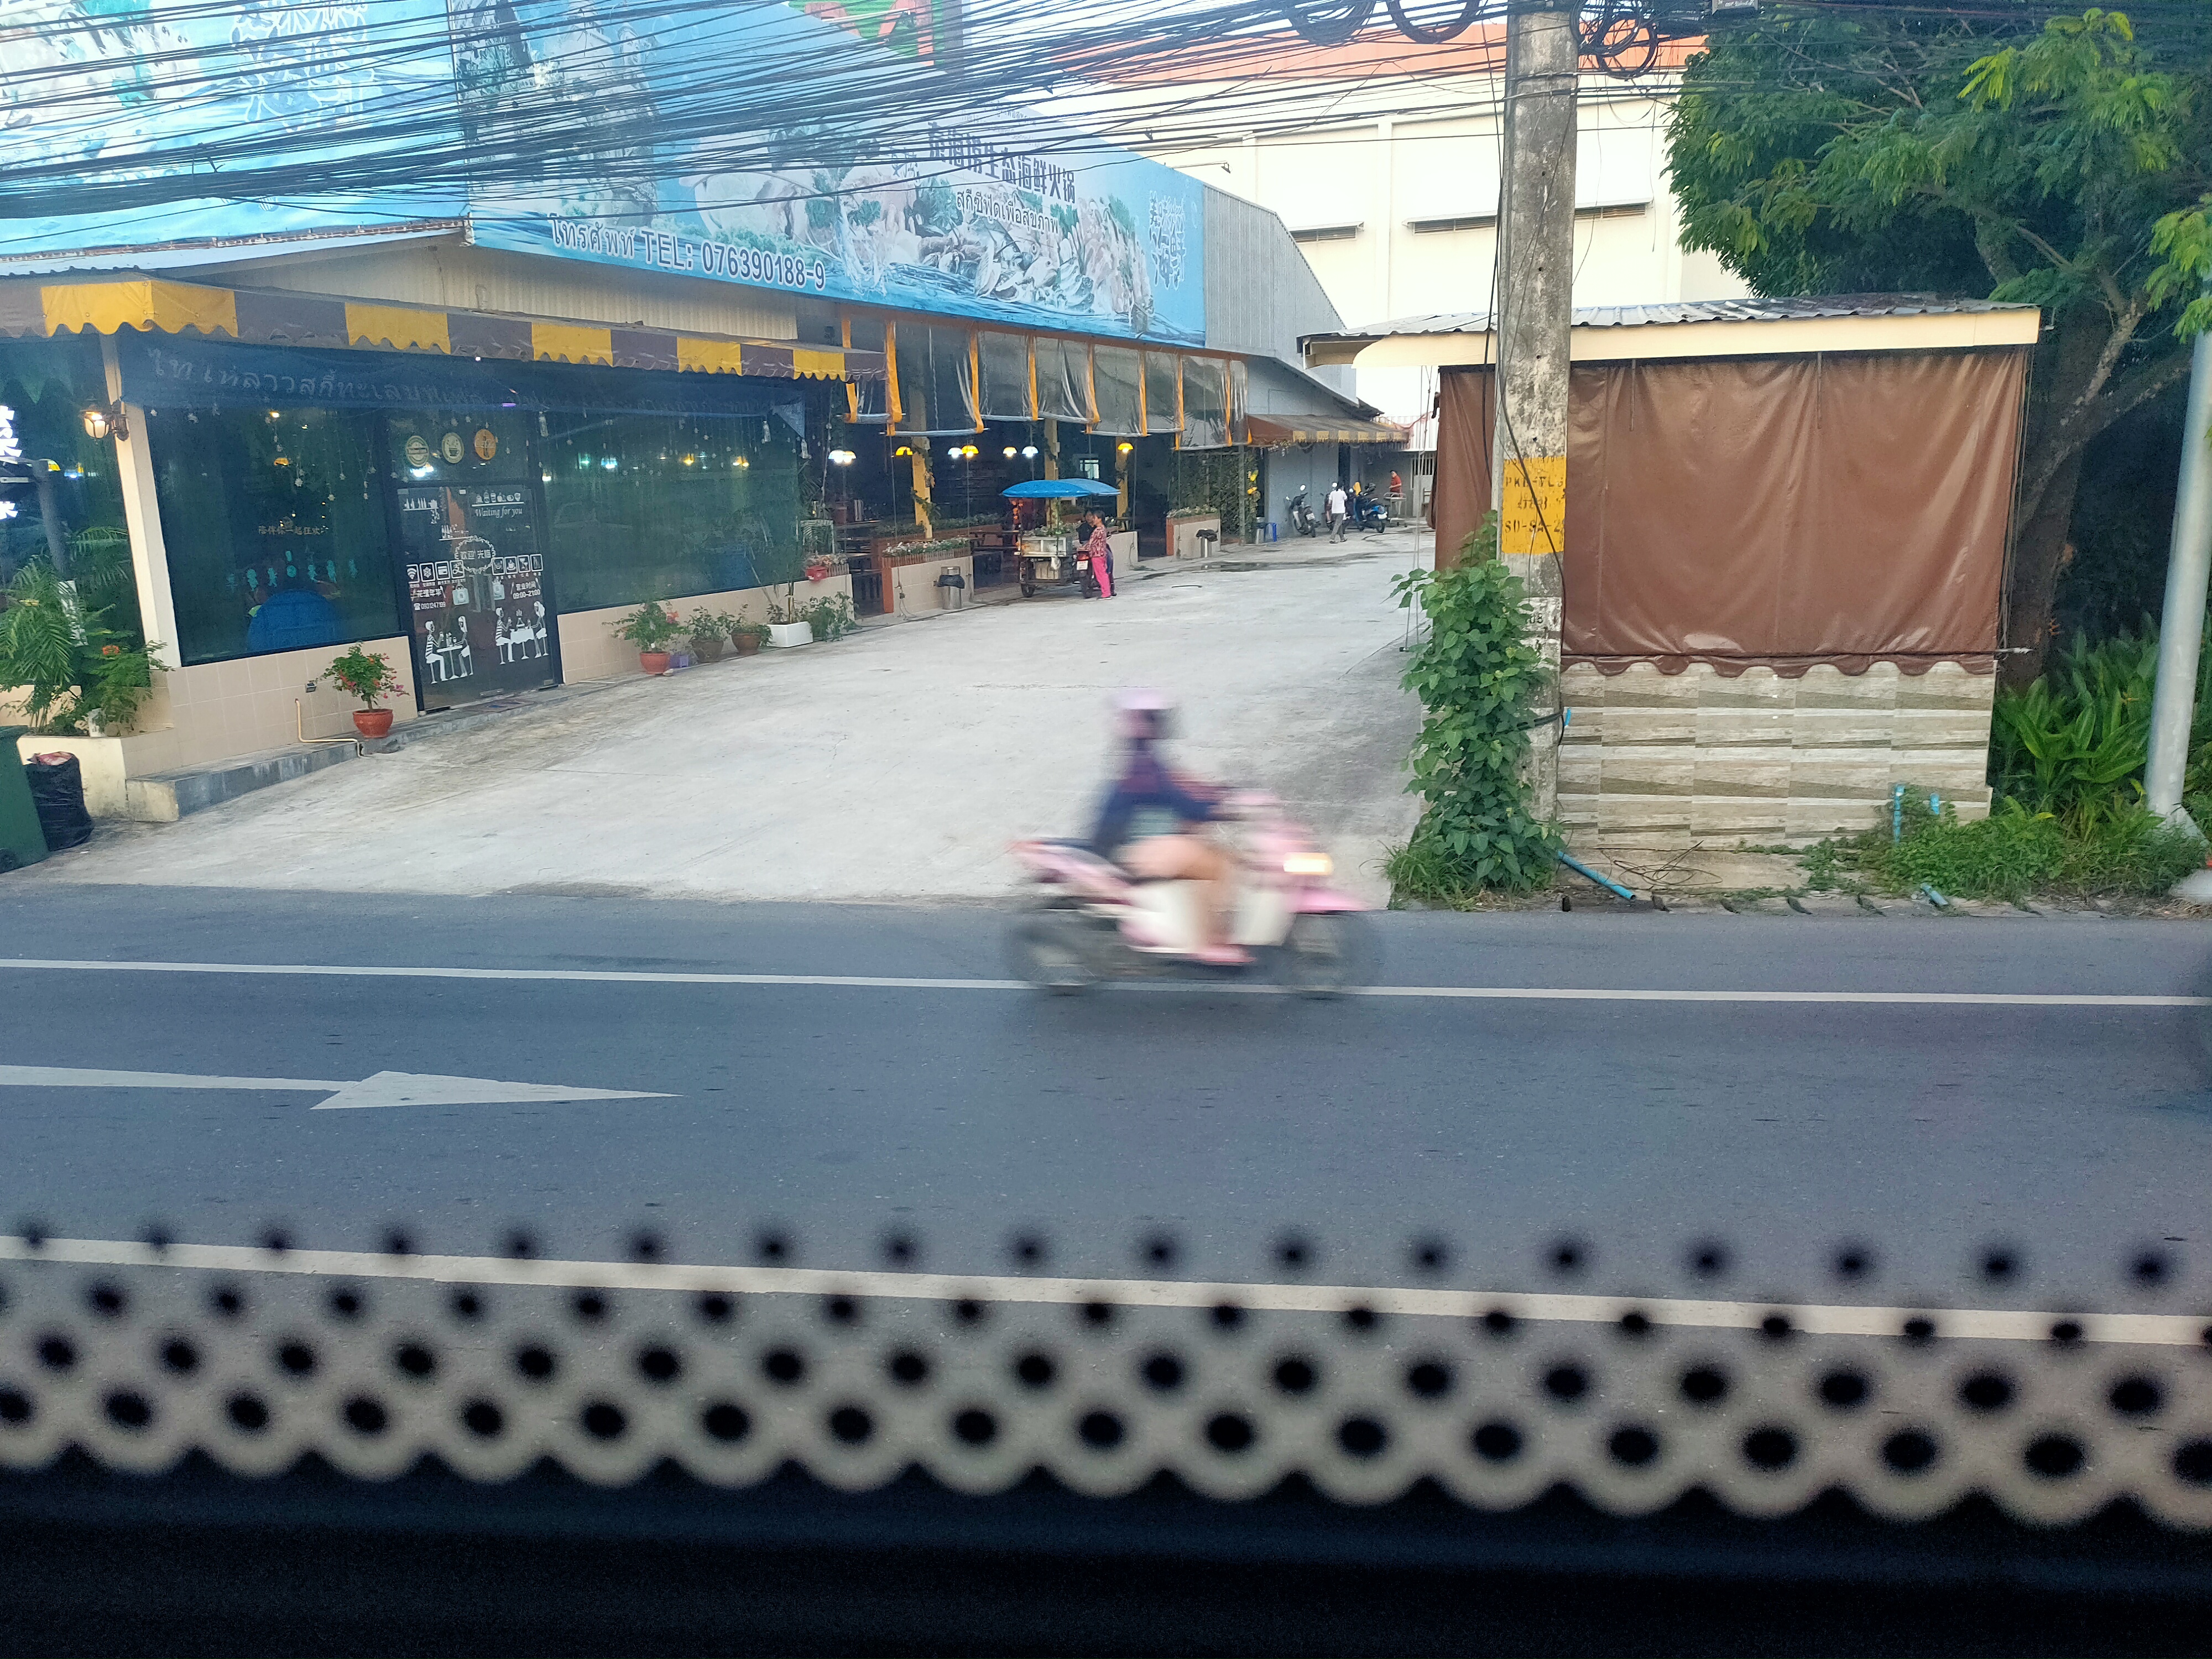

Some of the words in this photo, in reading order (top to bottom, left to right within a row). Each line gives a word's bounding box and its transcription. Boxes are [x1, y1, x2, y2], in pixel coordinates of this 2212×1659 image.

[640, 229, 693, 269] TEL:
[701, 241, 826, 290] 076390188-9
[474, 507, 500, 518] Waiting
[499, 507, 510, 518] for
[512, 507, 523, 518] you
[460, 550, 491, 560] 欢迎光临
